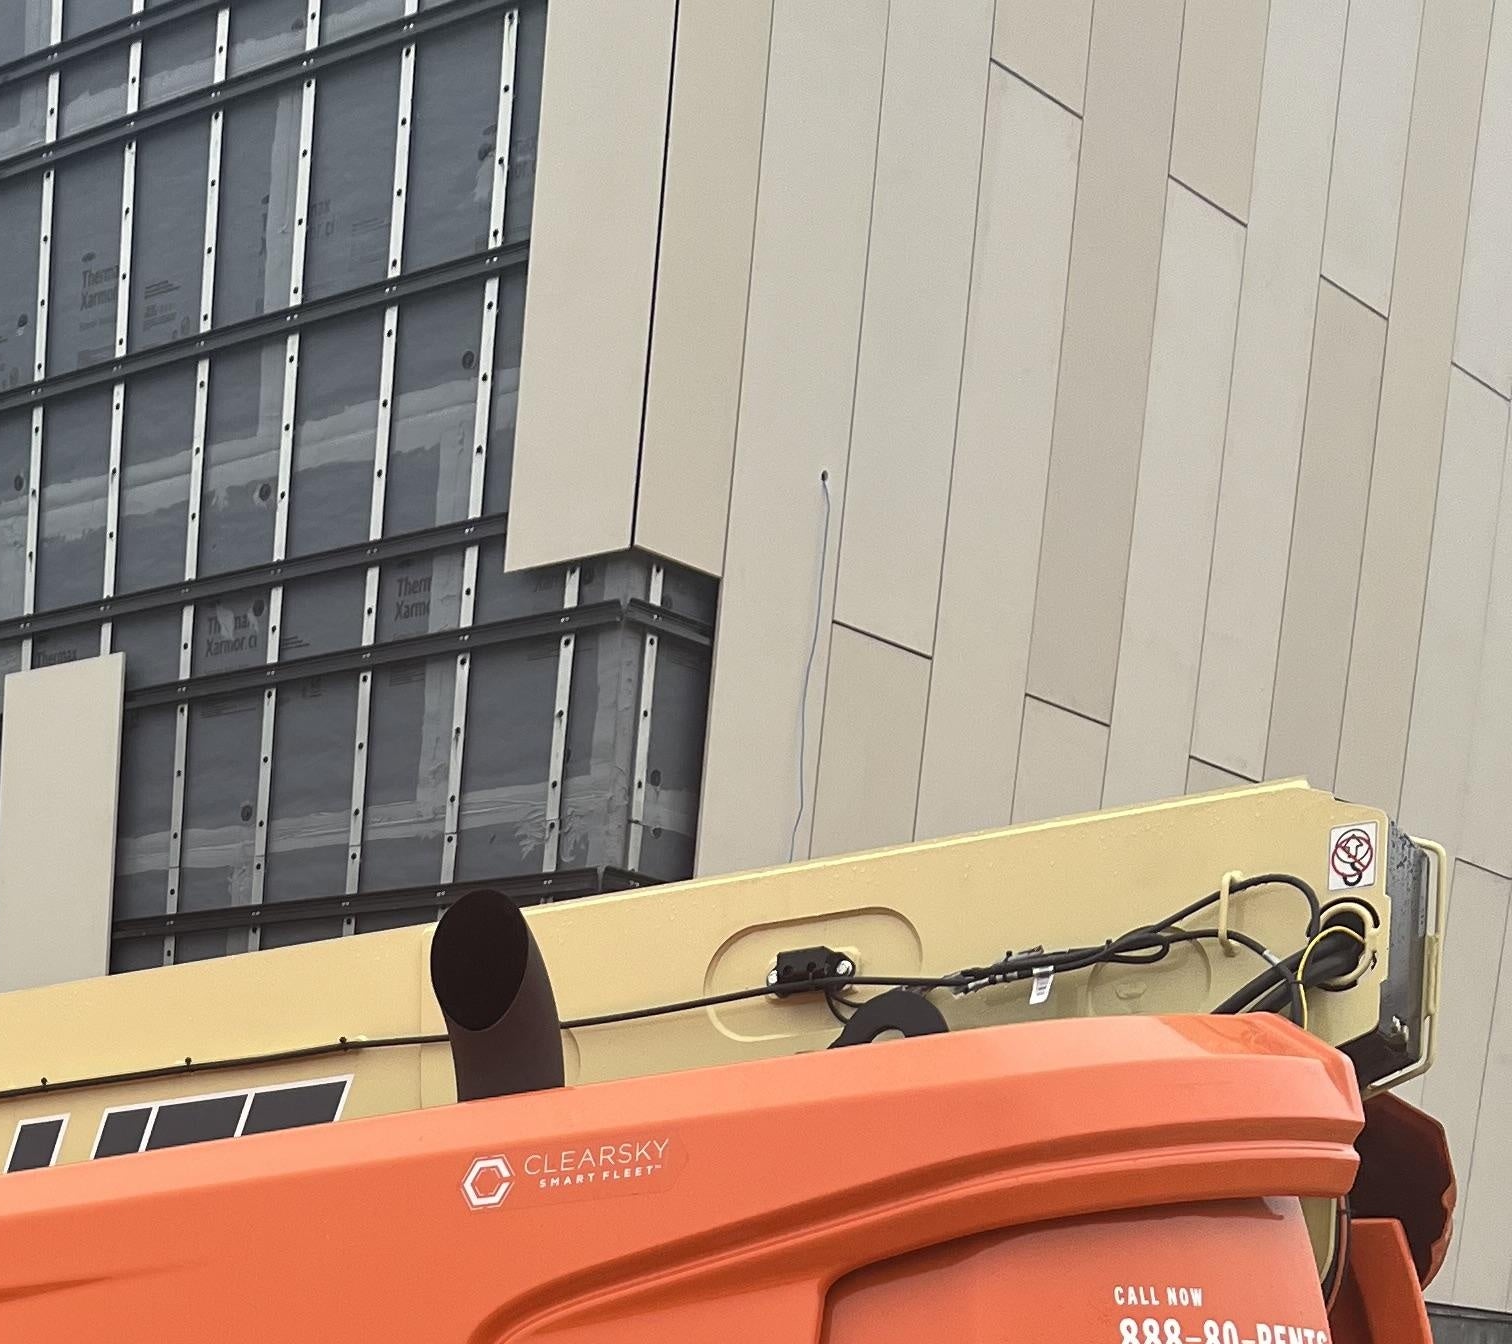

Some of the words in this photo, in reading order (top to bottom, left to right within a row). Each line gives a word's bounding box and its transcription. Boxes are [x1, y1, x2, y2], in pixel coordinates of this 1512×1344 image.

[205, 636, 245, 658] Xarmor
[523, 1138, 670, 1176] CLEARSKY
[538, 1173, 595, 1188] SMART
[1113, 1286, 1160, 1306] CALL
[1166, 1287, 1203, 1307] NOW
